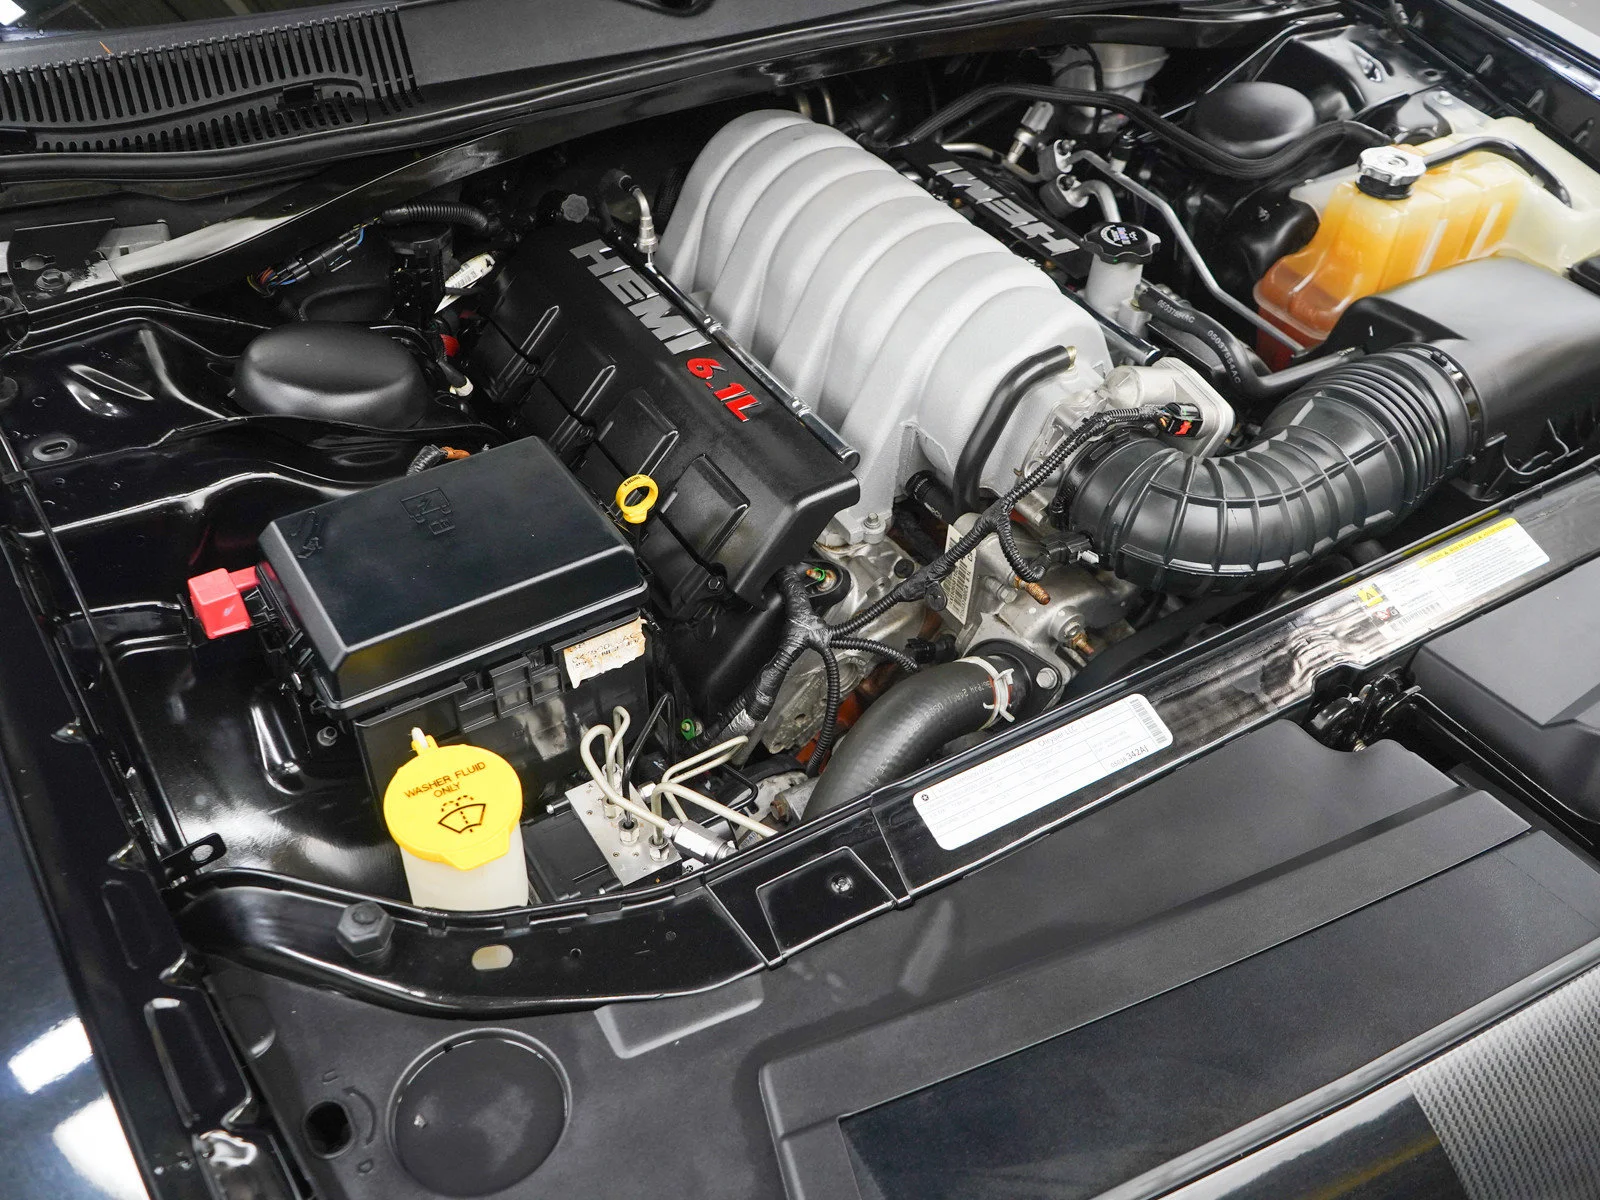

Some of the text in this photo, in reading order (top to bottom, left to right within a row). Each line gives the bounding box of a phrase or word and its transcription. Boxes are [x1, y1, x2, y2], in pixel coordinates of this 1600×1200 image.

[928, 160, 1081, 257] HEMI
[569, 238, 762, 422] HEMI 6.1L
[404, 761, 487, 798] WASHER FLUID
[433, 782, 461, 798] ONLY
